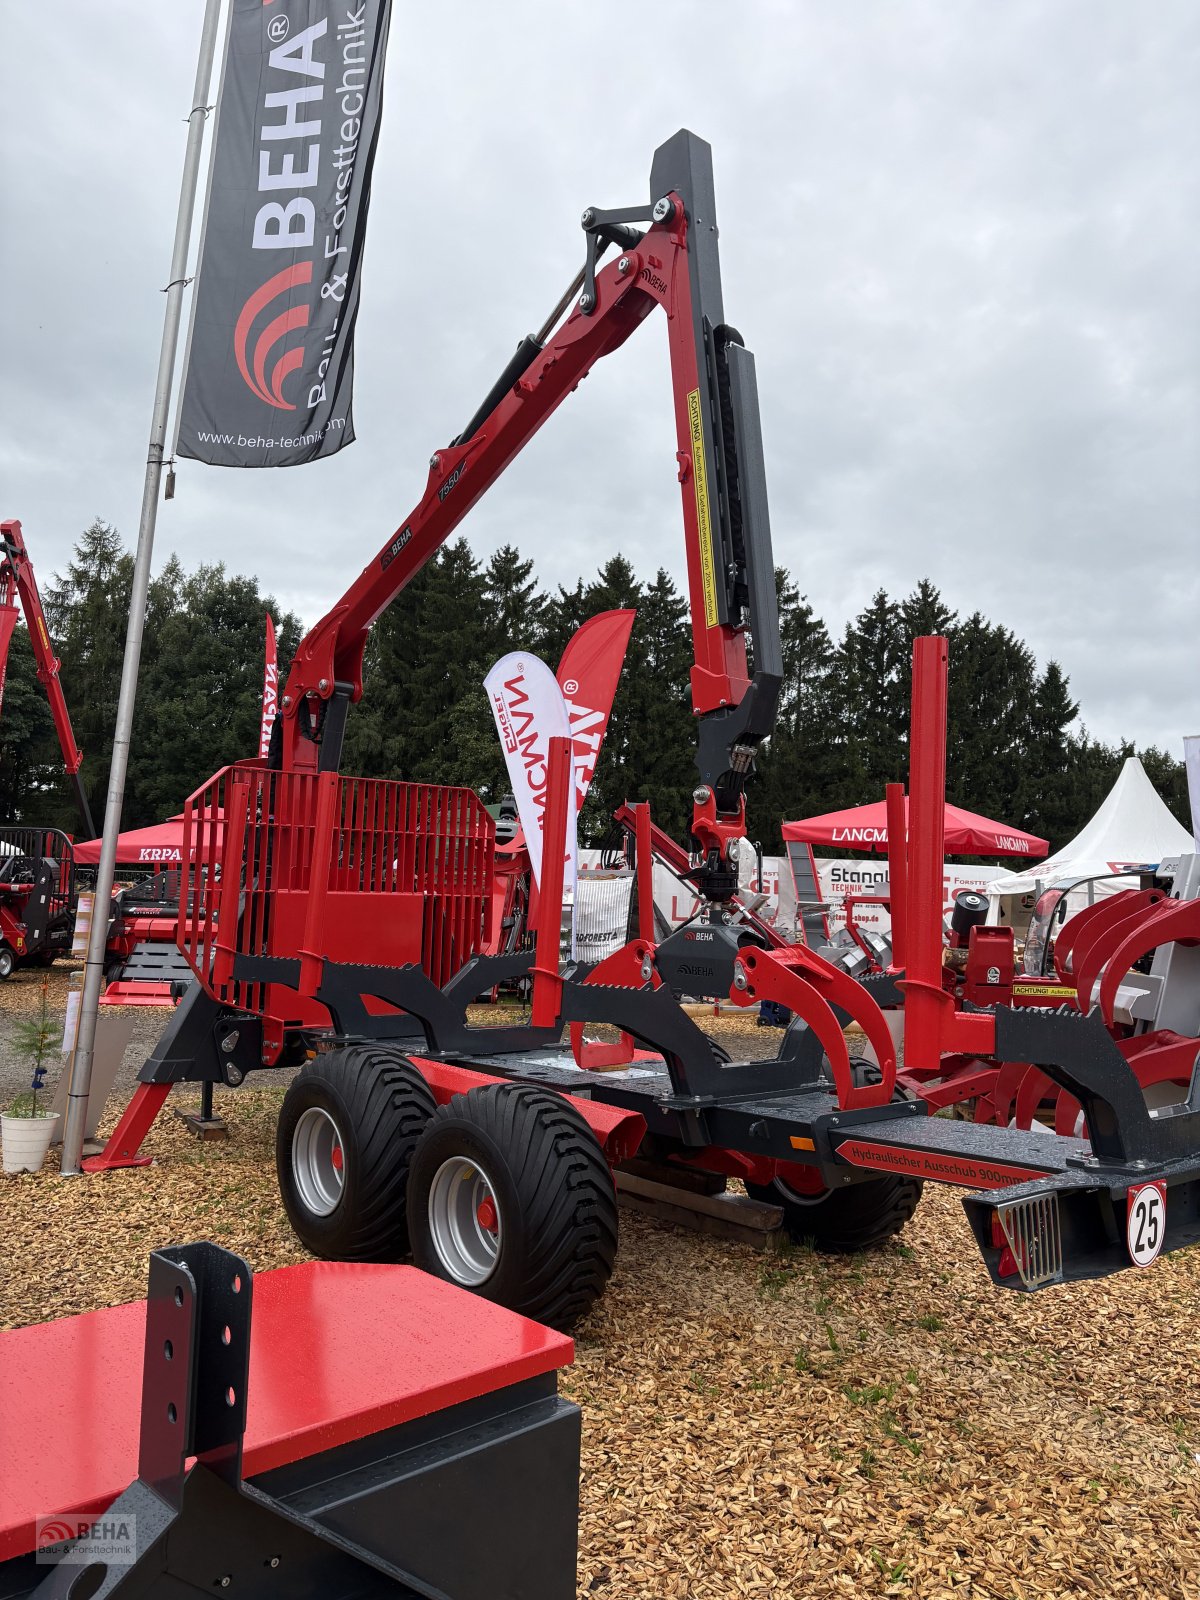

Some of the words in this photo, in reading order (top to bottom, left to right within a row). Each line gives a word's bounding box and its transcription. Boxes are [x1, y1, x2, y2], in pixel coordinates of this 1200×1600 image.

[325, 2, 367, 259] Forsttechnik
[320, 271, 348, 302] &
[650, 274, 668, 295] BEHA
[198, 416, 347, 449] www.beha-technik.om
[690, 394, 701, 443] ACHTUNG!
[391, 528, 412, 556] BEHA
[832, 828, 908, 842] LANCM
[995, 834, 1029, 853] LANCMAN
[831, 883, 863, 892] TECHNIK
[695, 932, 714, 942] BEHA
[692, 966, 714, 977] BEHA
[852, 1147, 921, 1168] Hydraulischer
[924, 1159, 977, 1178] Ausschub
[1134, 1198, 1160, 1254] 25
